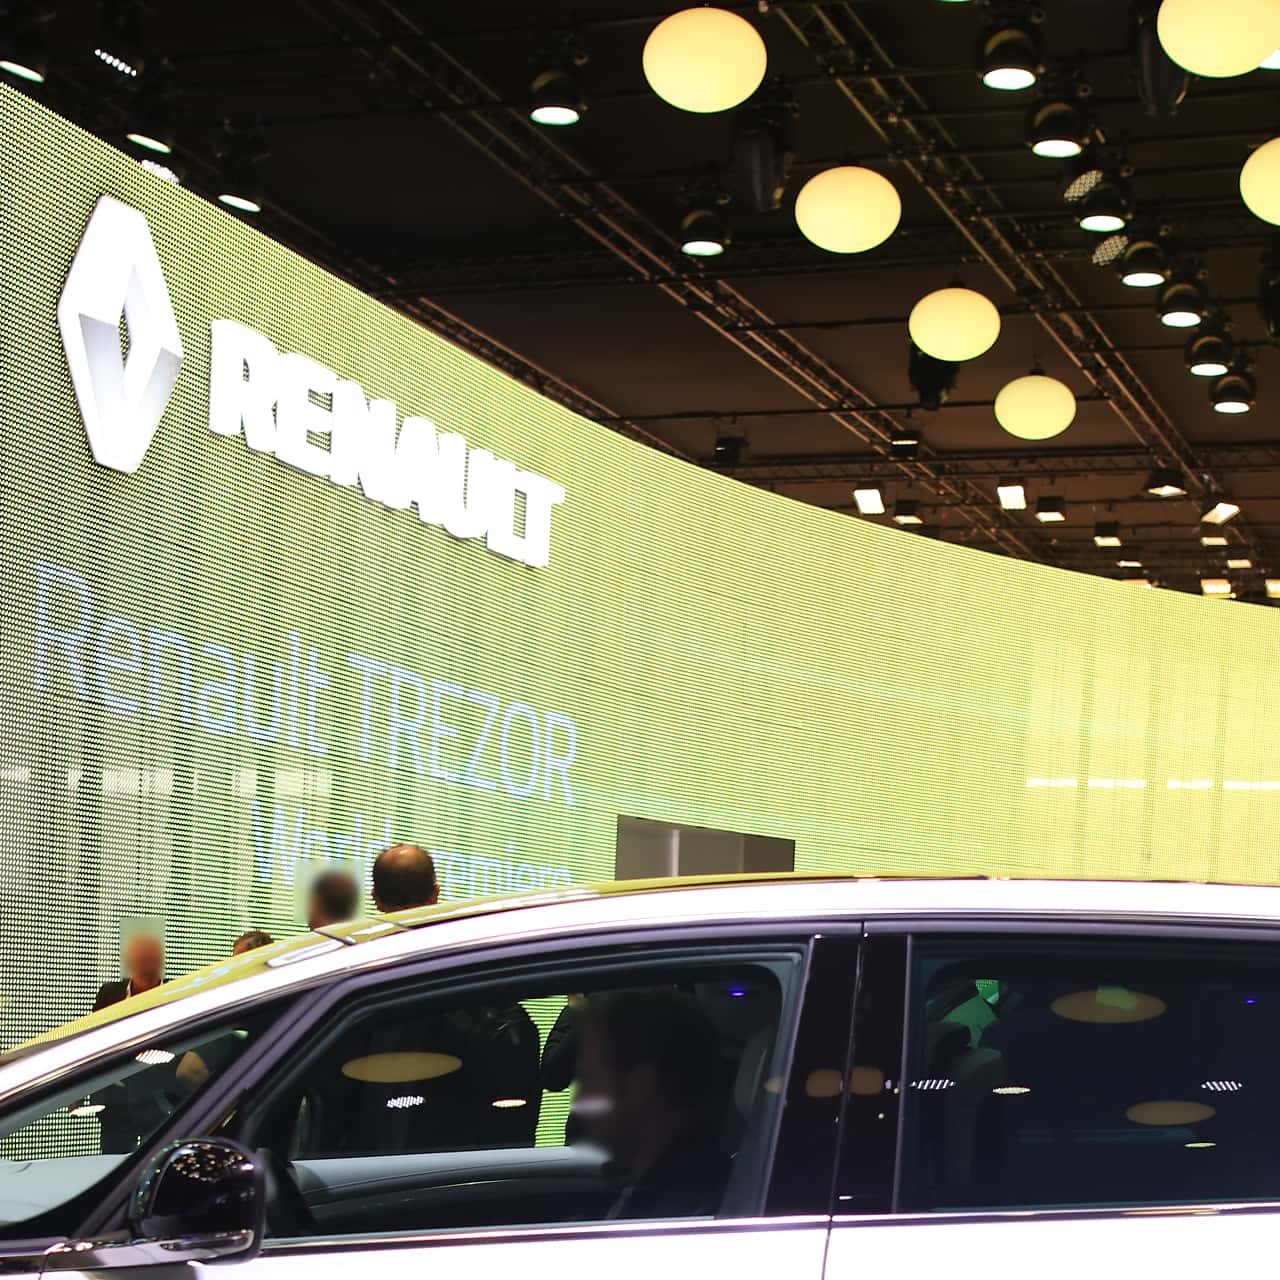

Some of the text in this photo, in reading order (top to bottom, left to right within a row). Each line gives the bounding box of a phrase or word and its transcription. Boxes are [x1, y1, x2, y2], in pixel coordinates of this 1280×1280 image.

[208, 317, 566, 568] RENAULT
[32, 559, 579, 808] Renault TREZOR
